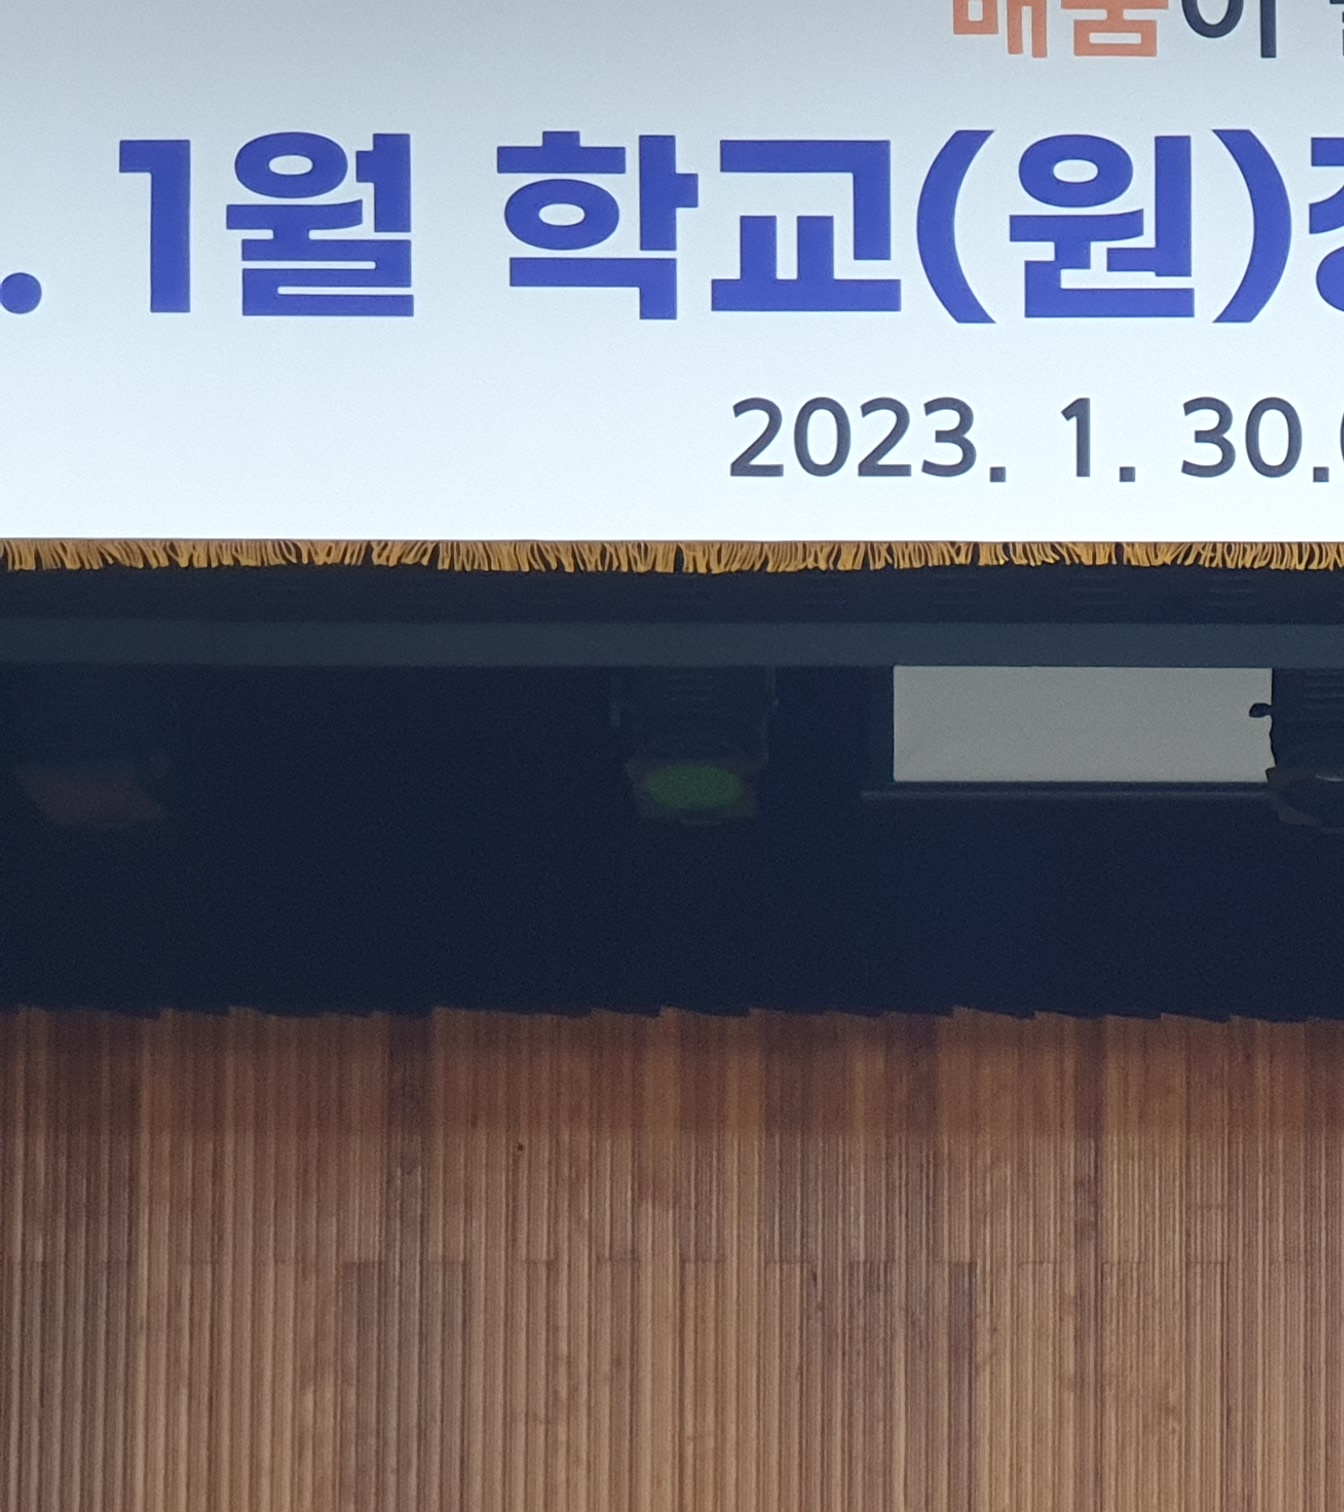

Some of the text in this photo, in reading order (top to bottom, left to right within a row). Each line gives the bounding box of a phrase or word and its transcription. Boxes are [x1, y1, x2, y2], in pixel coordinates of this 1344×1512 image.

[118, 130, 415, 318] 1월
[729, 396, 1007, 484] 2023.
[1060, 397, 1136, 483] 1.
